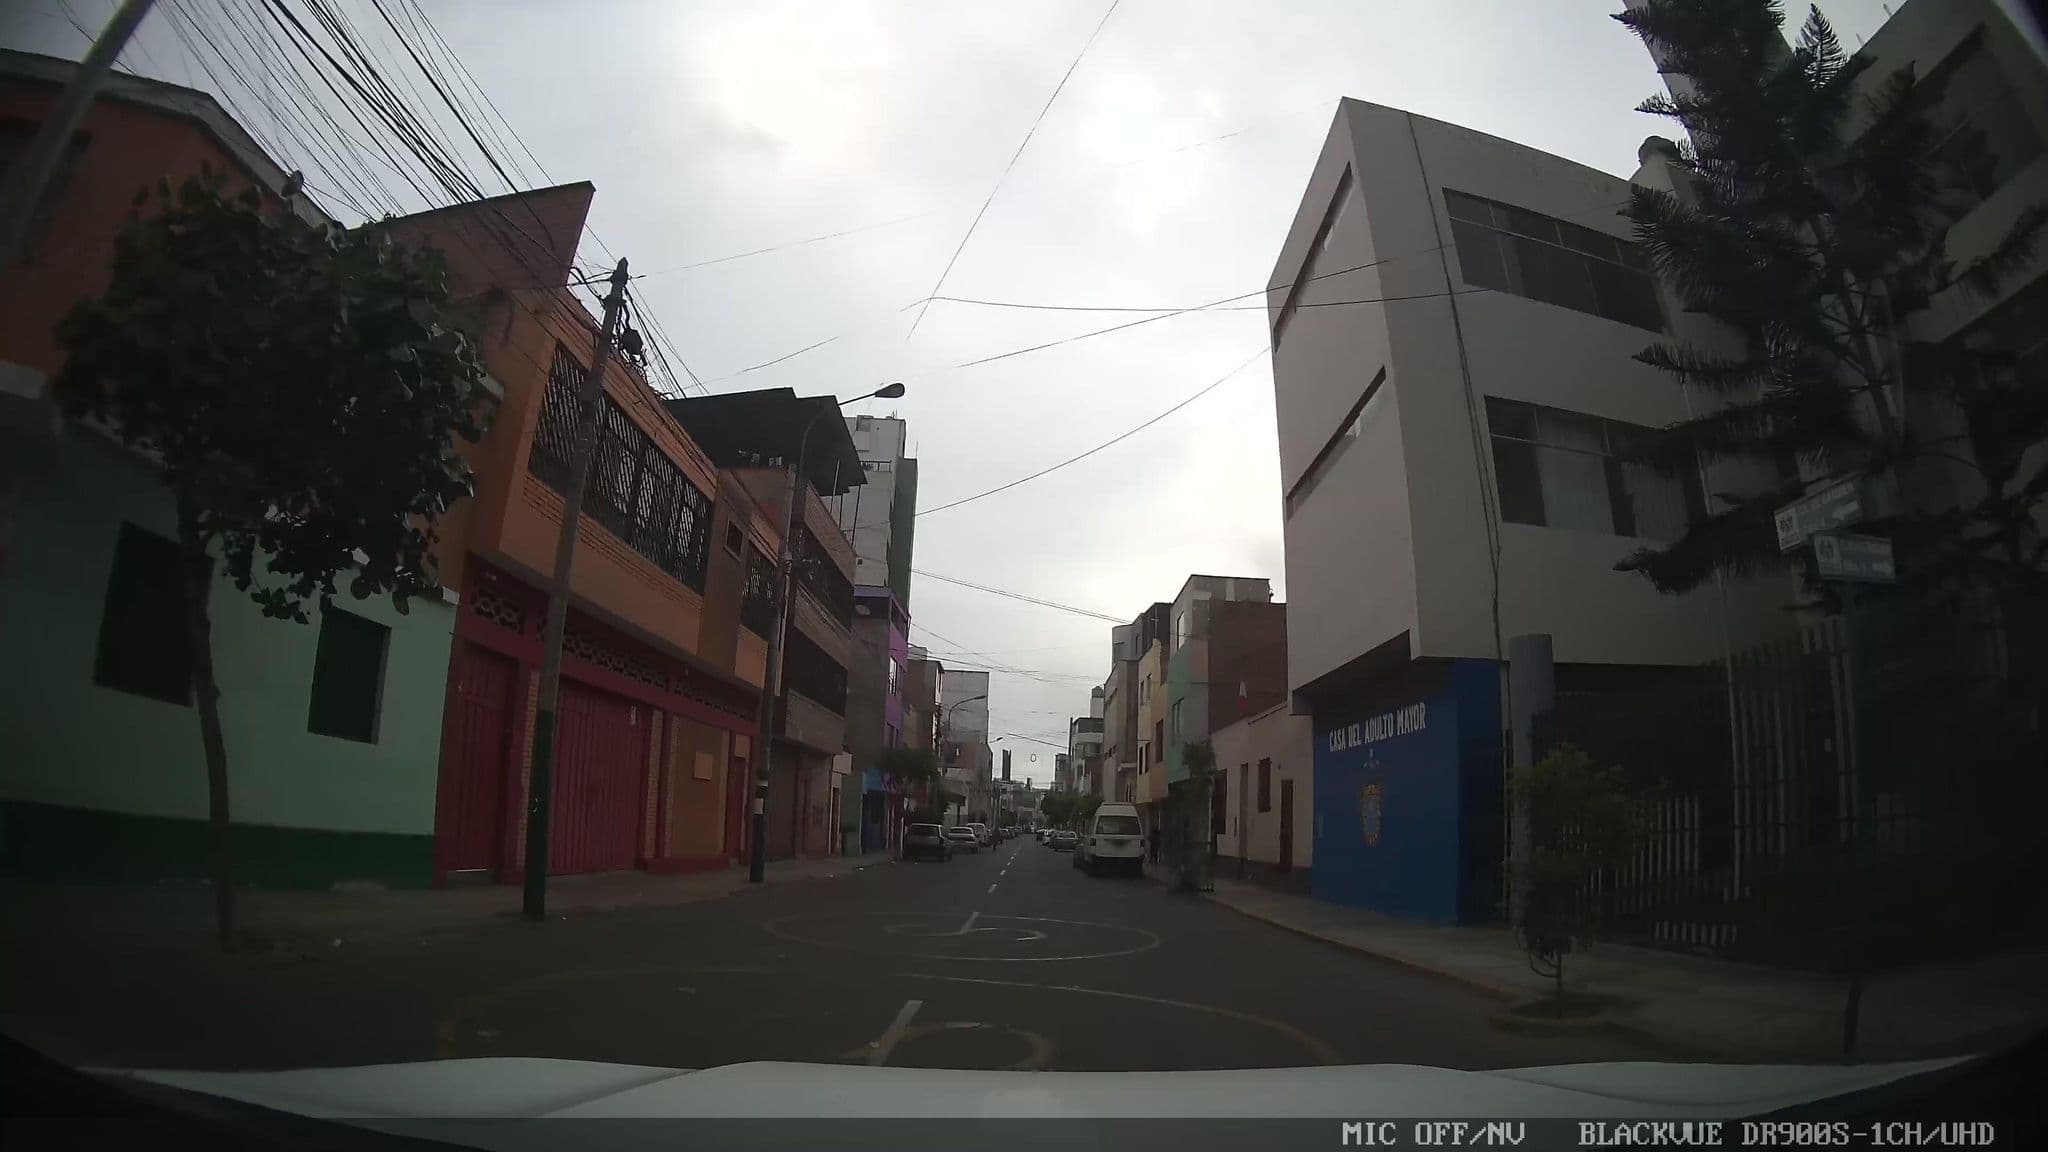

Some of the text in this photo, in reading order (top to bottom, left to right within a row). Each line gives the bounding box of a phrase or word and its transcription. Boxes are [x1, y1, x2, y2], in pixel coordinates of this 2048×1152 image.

[1329, 702, 1426, 752] CASA DEL ADULTO MAYOR
